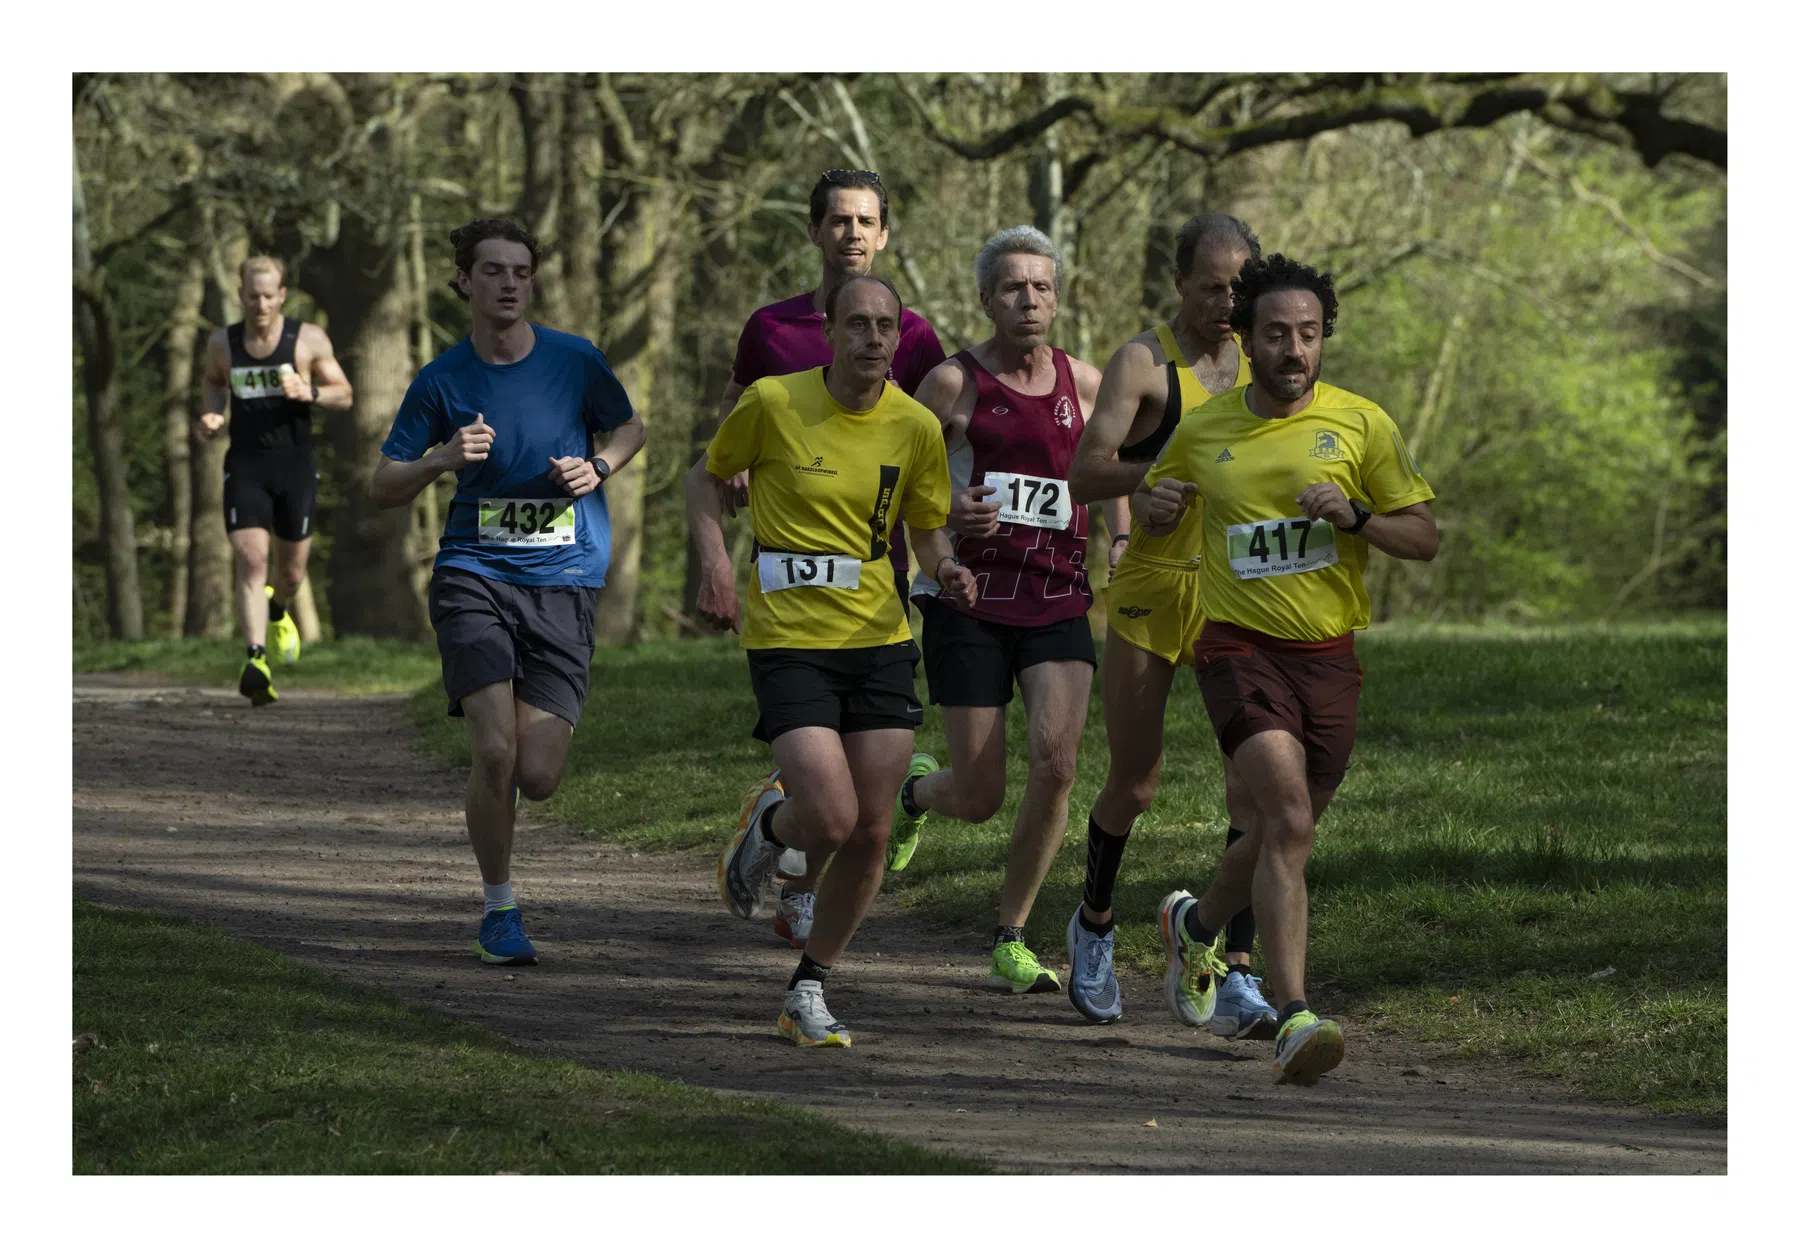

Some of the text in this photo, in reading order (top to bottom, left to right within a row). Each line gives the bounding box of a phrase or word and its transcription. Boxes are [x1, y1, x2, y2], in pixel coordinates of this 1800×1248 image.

[245, 369, 281, 389] 418
[1008, 478, 1060, 517] 172
[500, 502, 555, 535] 432
[1000, 511, 1048, 524] Hague Royal Ten
[518, 536, 535, 544] Royal
[1249, 520, 1311, 563] 417
[781, 557, 834, 585] 131
[1246, 566, 1270, 576] Hague
[1271, 563, 1292, 574] Royal
[1294, 561, 1307, 569] Ten
